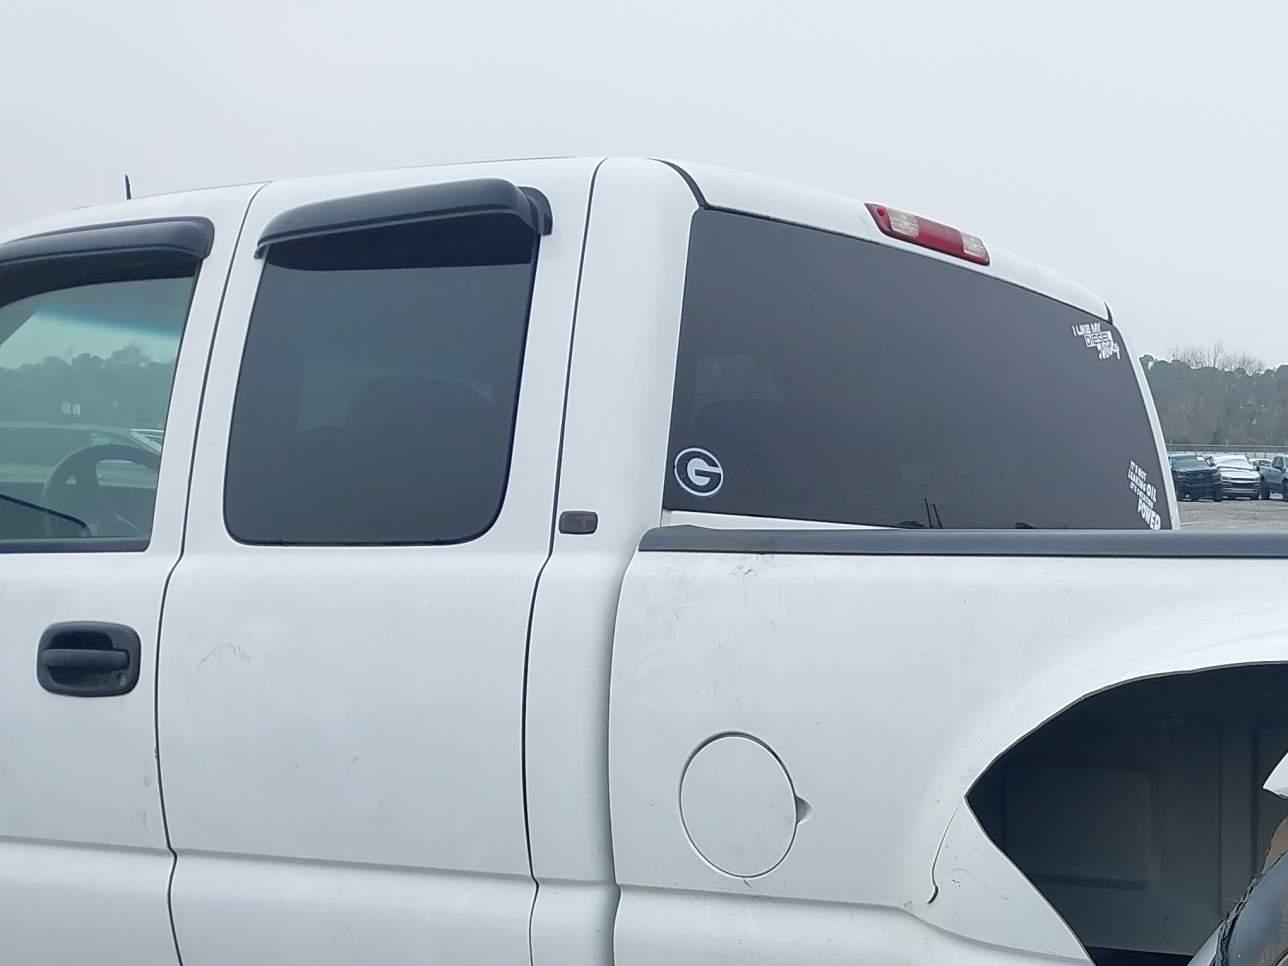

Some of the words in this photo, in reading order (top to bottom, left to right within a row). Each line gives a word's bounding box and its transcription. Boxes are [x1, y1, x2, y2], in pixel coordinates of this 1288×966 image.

[1084, 331, 1112, 346] DIESEL
[674, 447, 724, 496] G
[1146, 483, 1157, 503] OIL
